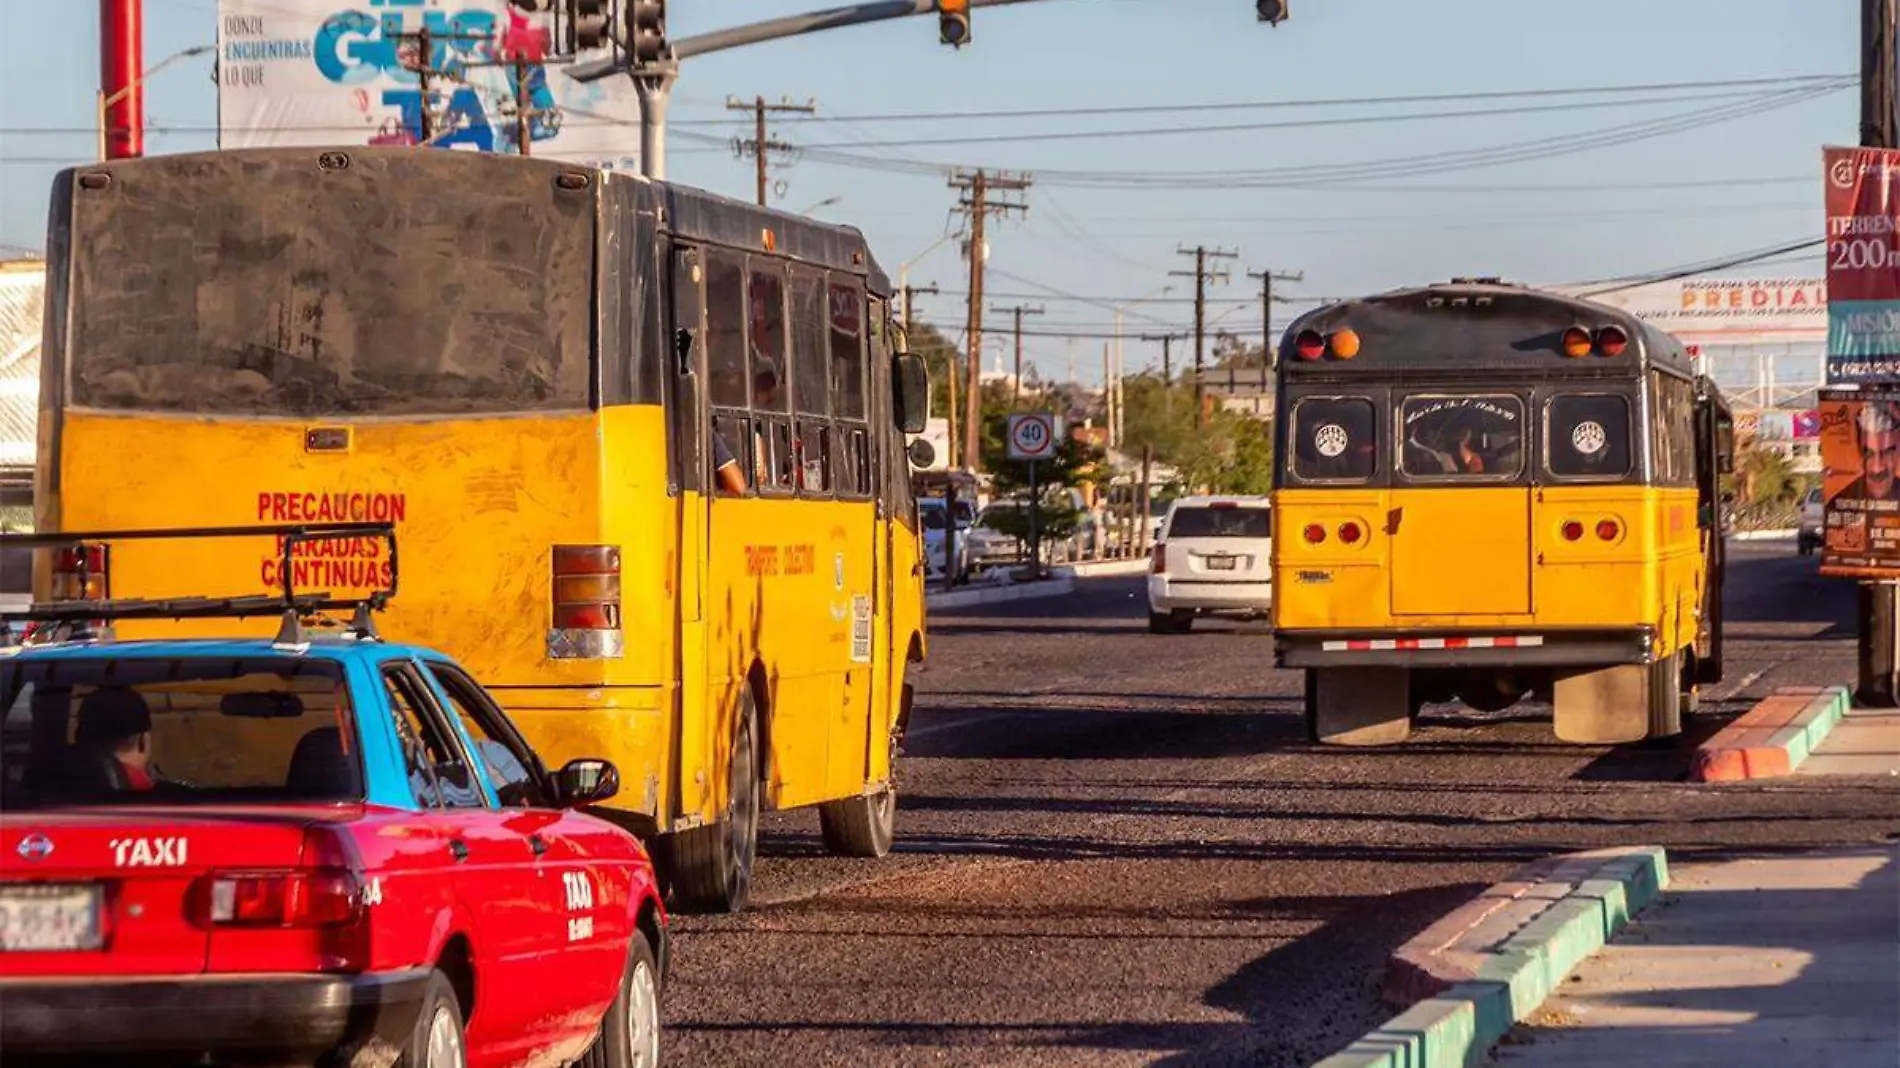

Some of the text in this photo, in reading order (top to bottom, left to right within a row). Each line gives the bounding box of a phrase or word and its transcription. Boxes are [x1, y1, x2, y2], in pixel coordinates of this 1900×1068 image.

[224, 16, 264, 35] DONDE
[225, 41, 311, 60] ENCUENTRAS
[224, 66, 265, 88] LO QUE
[1682, 288, 1827, 309] PREDIAL
[1022, 423, 1041, 441] 40
[258, 492, 405, 521] PRECAUCION
[109, 837, 188, 866] TAXI
